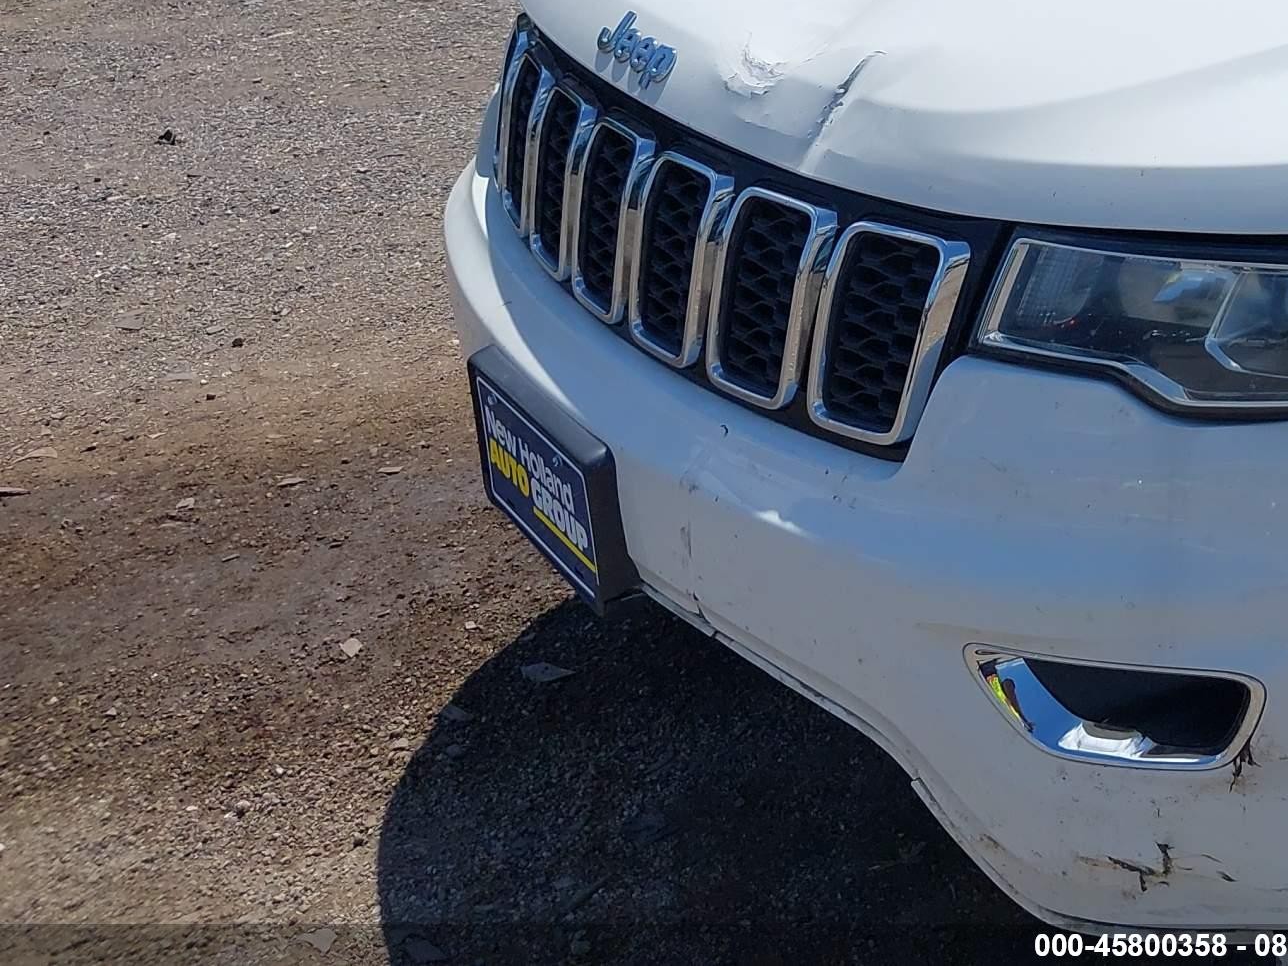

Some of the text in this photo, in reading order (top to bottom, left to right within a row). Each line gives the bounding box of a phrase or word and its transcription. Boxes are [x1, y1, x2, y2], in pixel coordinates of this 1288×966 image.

[597, 10, 677, 90] Jeep
[484, 406, 576, 514] New Holland
[489, 438, 589, 552] AUTO GROUP
